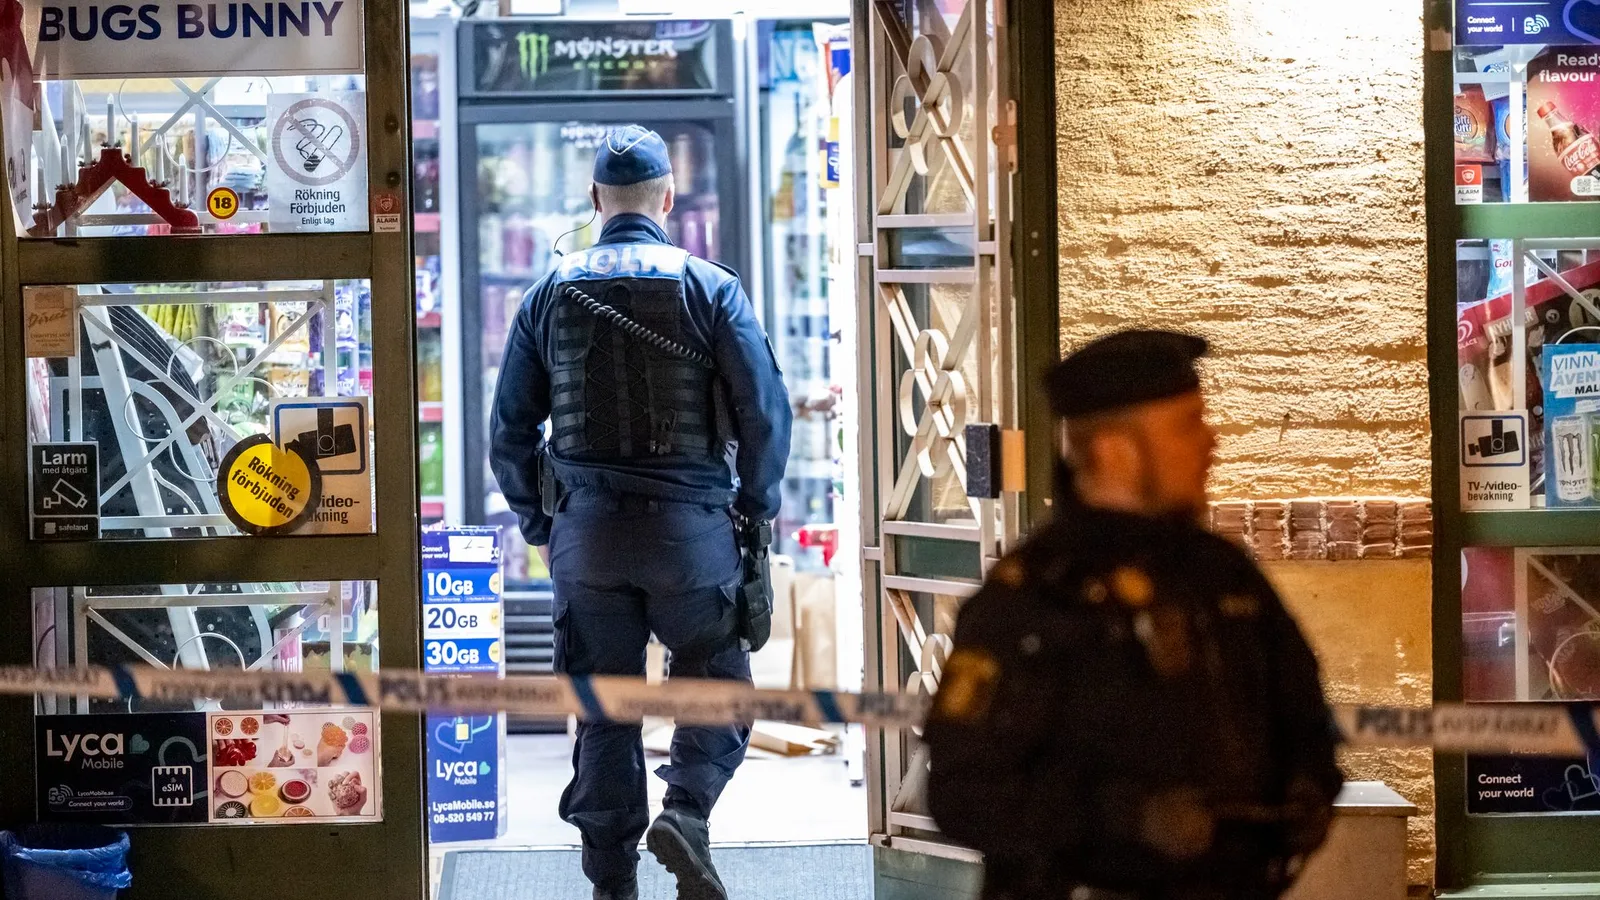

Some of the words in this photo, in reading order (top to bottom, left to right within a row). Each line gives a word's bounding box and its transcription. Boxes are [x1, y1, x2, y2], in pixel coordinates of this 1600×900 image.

[39, 4, 162, 41] BUGS
[177, 1, 343, 39] BUNNY
[1467, 16, 1496, 24] Connect
[1467, 25, 1483, 34] your
[1484, 25, 1504, 33] world
[554, 36, 678, 59] MONSTER
[573, 59, 659, 70] ENERGY
[1557, 53, 1600, 68] Read
[1539, 69, 1596, 83] flavour
[295, 189, 340, 202] Rökning
[213, 197, 232, 209] 18
[290, 202, 346, 217] Förbjuden
[301, 217, 322, 226] Enligt
[323, 217, 335, 226] lag
[1553, 353, 1594, 371] VINN
[1574, 385, 1600, 395] MAL
[42, 450, 87, 465] Larm
[42, 466, 60, 474] med
[61, 465, 88, 475] åtgärd
[247, 456, 300, 501] Rökning
[1467, 481, 1522, 491] TV-/video-
[231, 469, 294, 519] förbjuden
[1467, 491, 1514, 502] bevakning
[322, 495, 360, 508] ideo-
[427, 572, 474, 596] 10GB
[428, 607, 478, 629] 20GB
[426, 640, 480, 666] 30GB
[46, 729, 124, 762] Lyca
[81, 758, 124, 769] Mobile
[436, 759, 477, 781] Lyca
[454, 777, 477, 785] Mobile
[1478, 773, 1522, 784] Connect
[162, 783, 184, 792] eSIM
[1478, 790, 1502, 800] your
[1504, 787, 1534, 798] world
[433, 799, 496, 813] LycaMobile.se
[433, 813, 464, 824] 08-520
[466, 812, 483, 822] 549
[484, 811, 495, 821] 77
